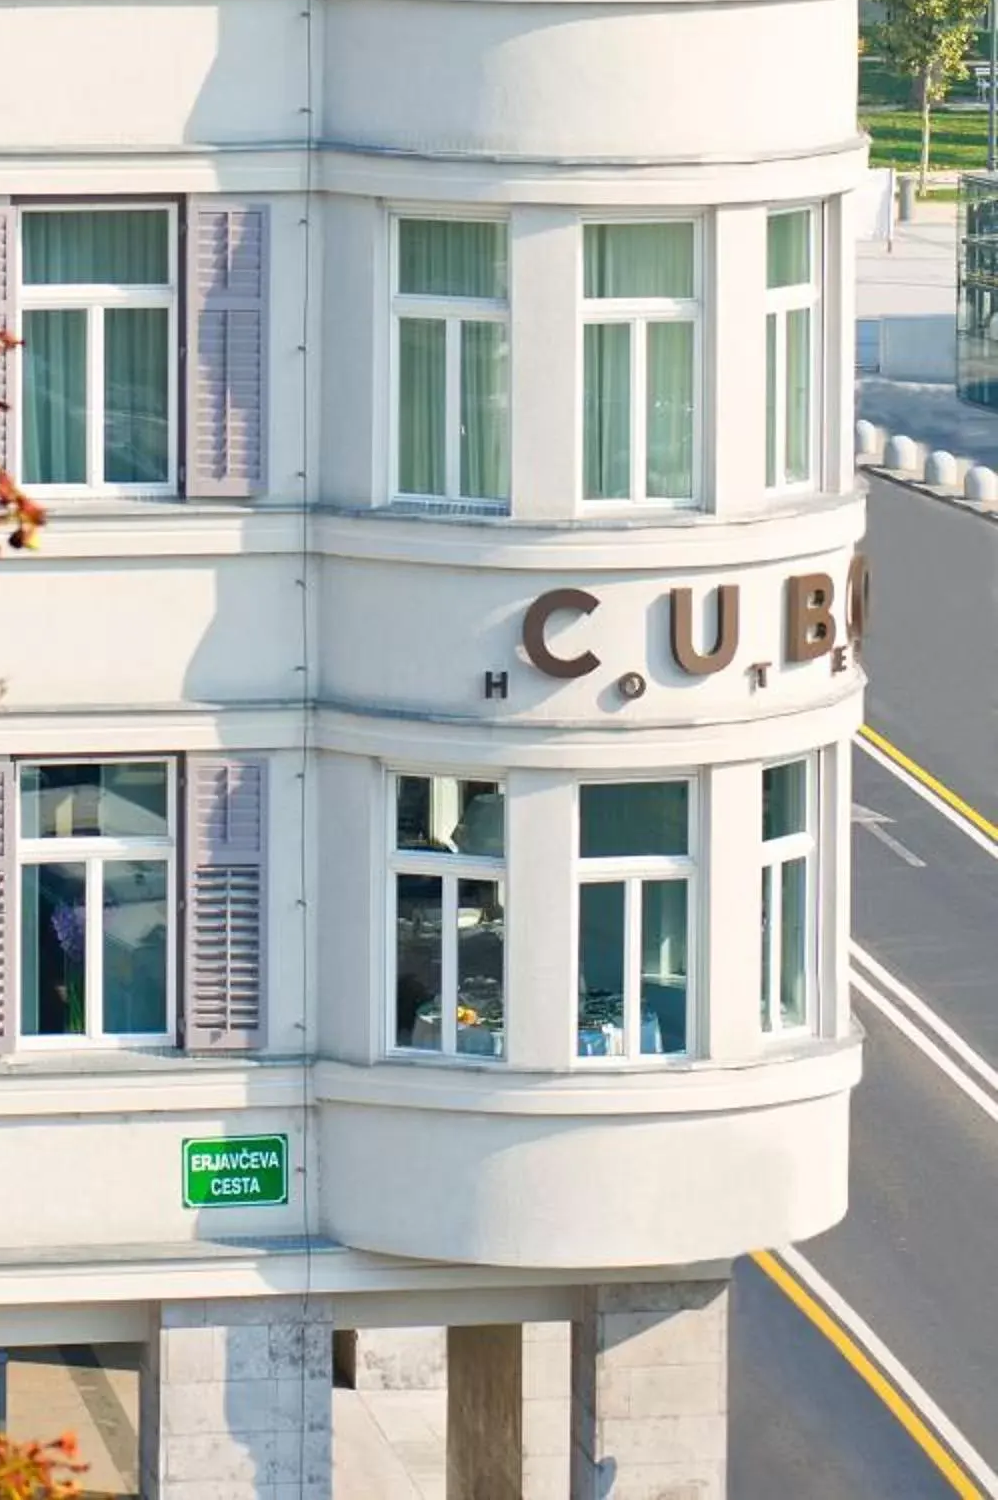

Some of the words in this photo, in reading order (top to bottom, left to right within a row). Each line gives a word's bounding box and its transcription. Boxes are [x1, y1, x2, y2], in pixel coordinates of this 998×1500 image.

[485, 640, 860, 699] HOTE
[191, 1148, 279, 1172] ERJAVČEVA
[211, 1177, 260, 1196] CESTA
